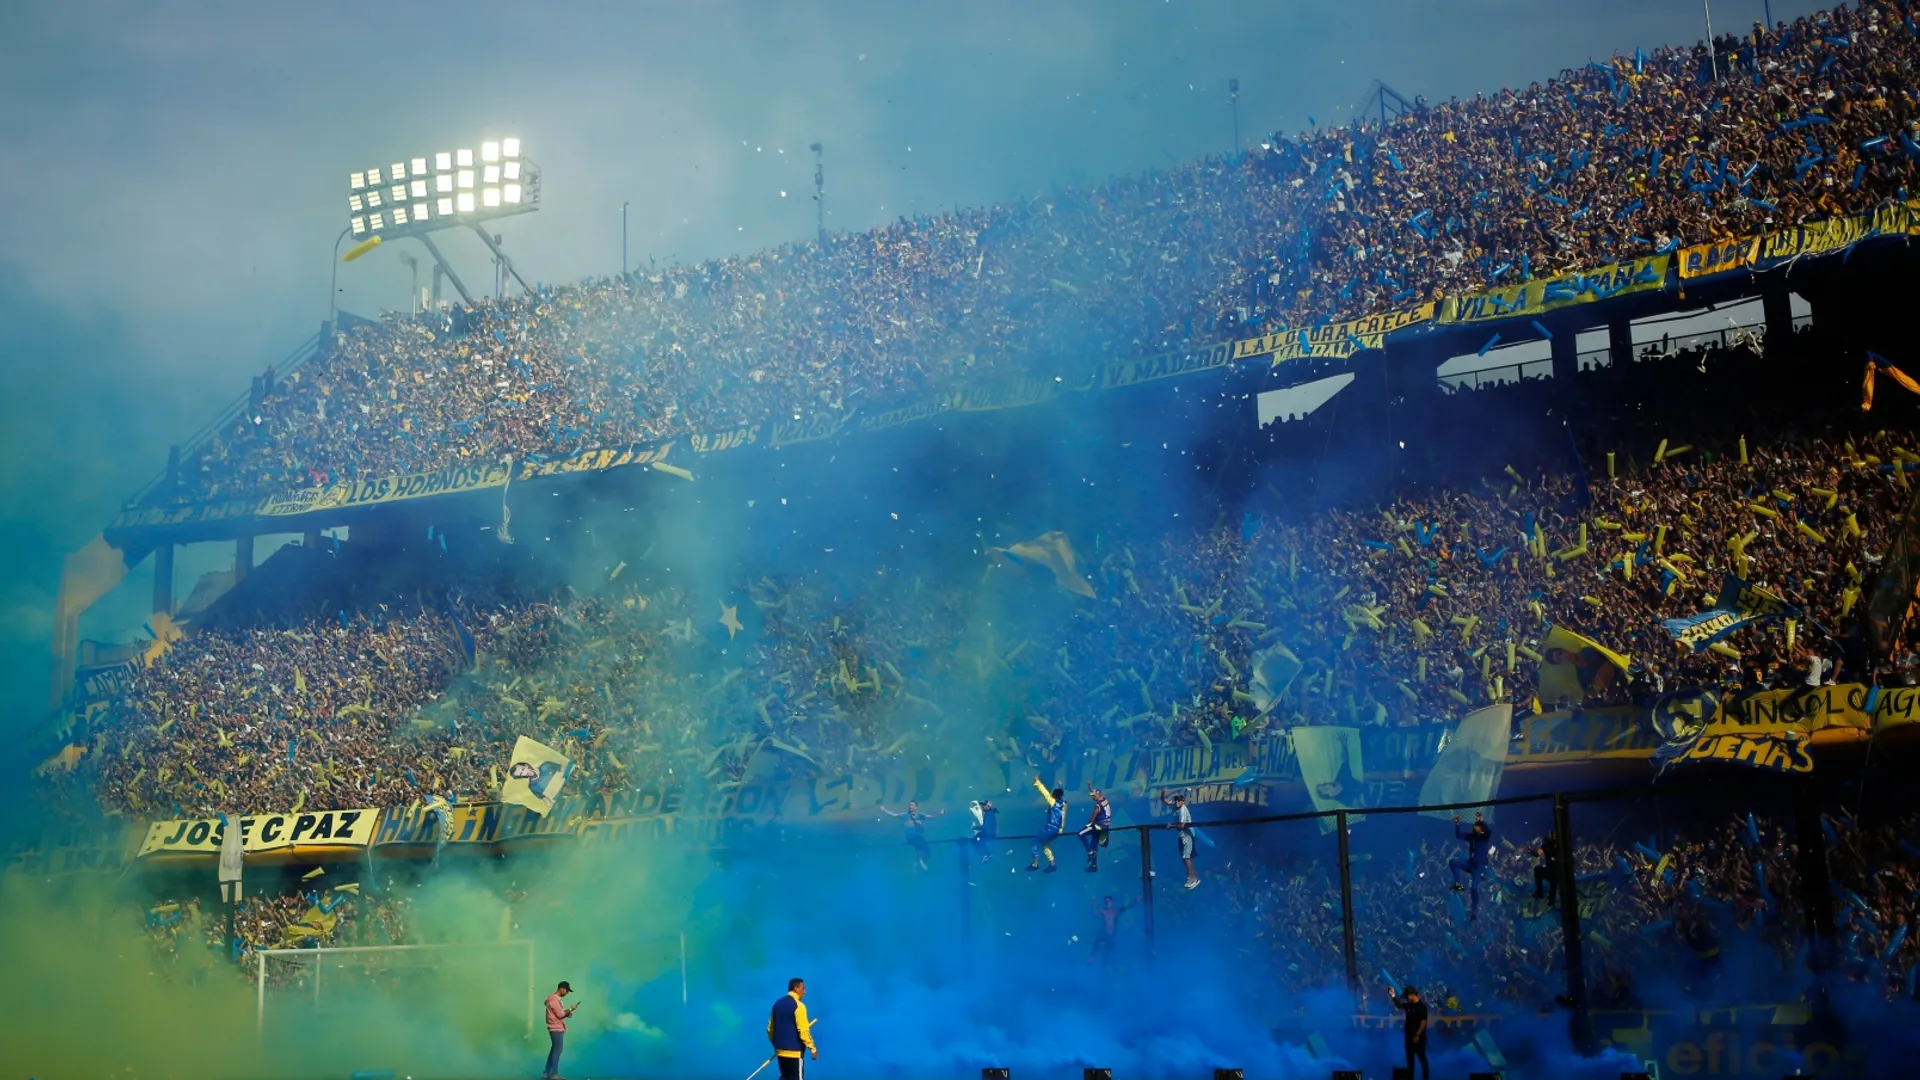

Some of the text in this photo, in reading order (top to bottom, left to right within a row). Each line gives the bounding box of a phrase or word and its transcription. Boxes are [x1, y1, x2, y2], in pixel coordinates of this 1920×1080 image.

[1457, 288, 1526, 320] VILLA
[1240, 307, 1421, 356] LA LOURA CRECE
[347, 480, 390, 503] LOS
[391, 462, 482, 497] HORNOS
[1706, 688, 1920, 727] HINGOLO AG
[1149, 744, 1221, 784] CAPILLA
[164, 811, 362, 846] JOSE C. PAZ
